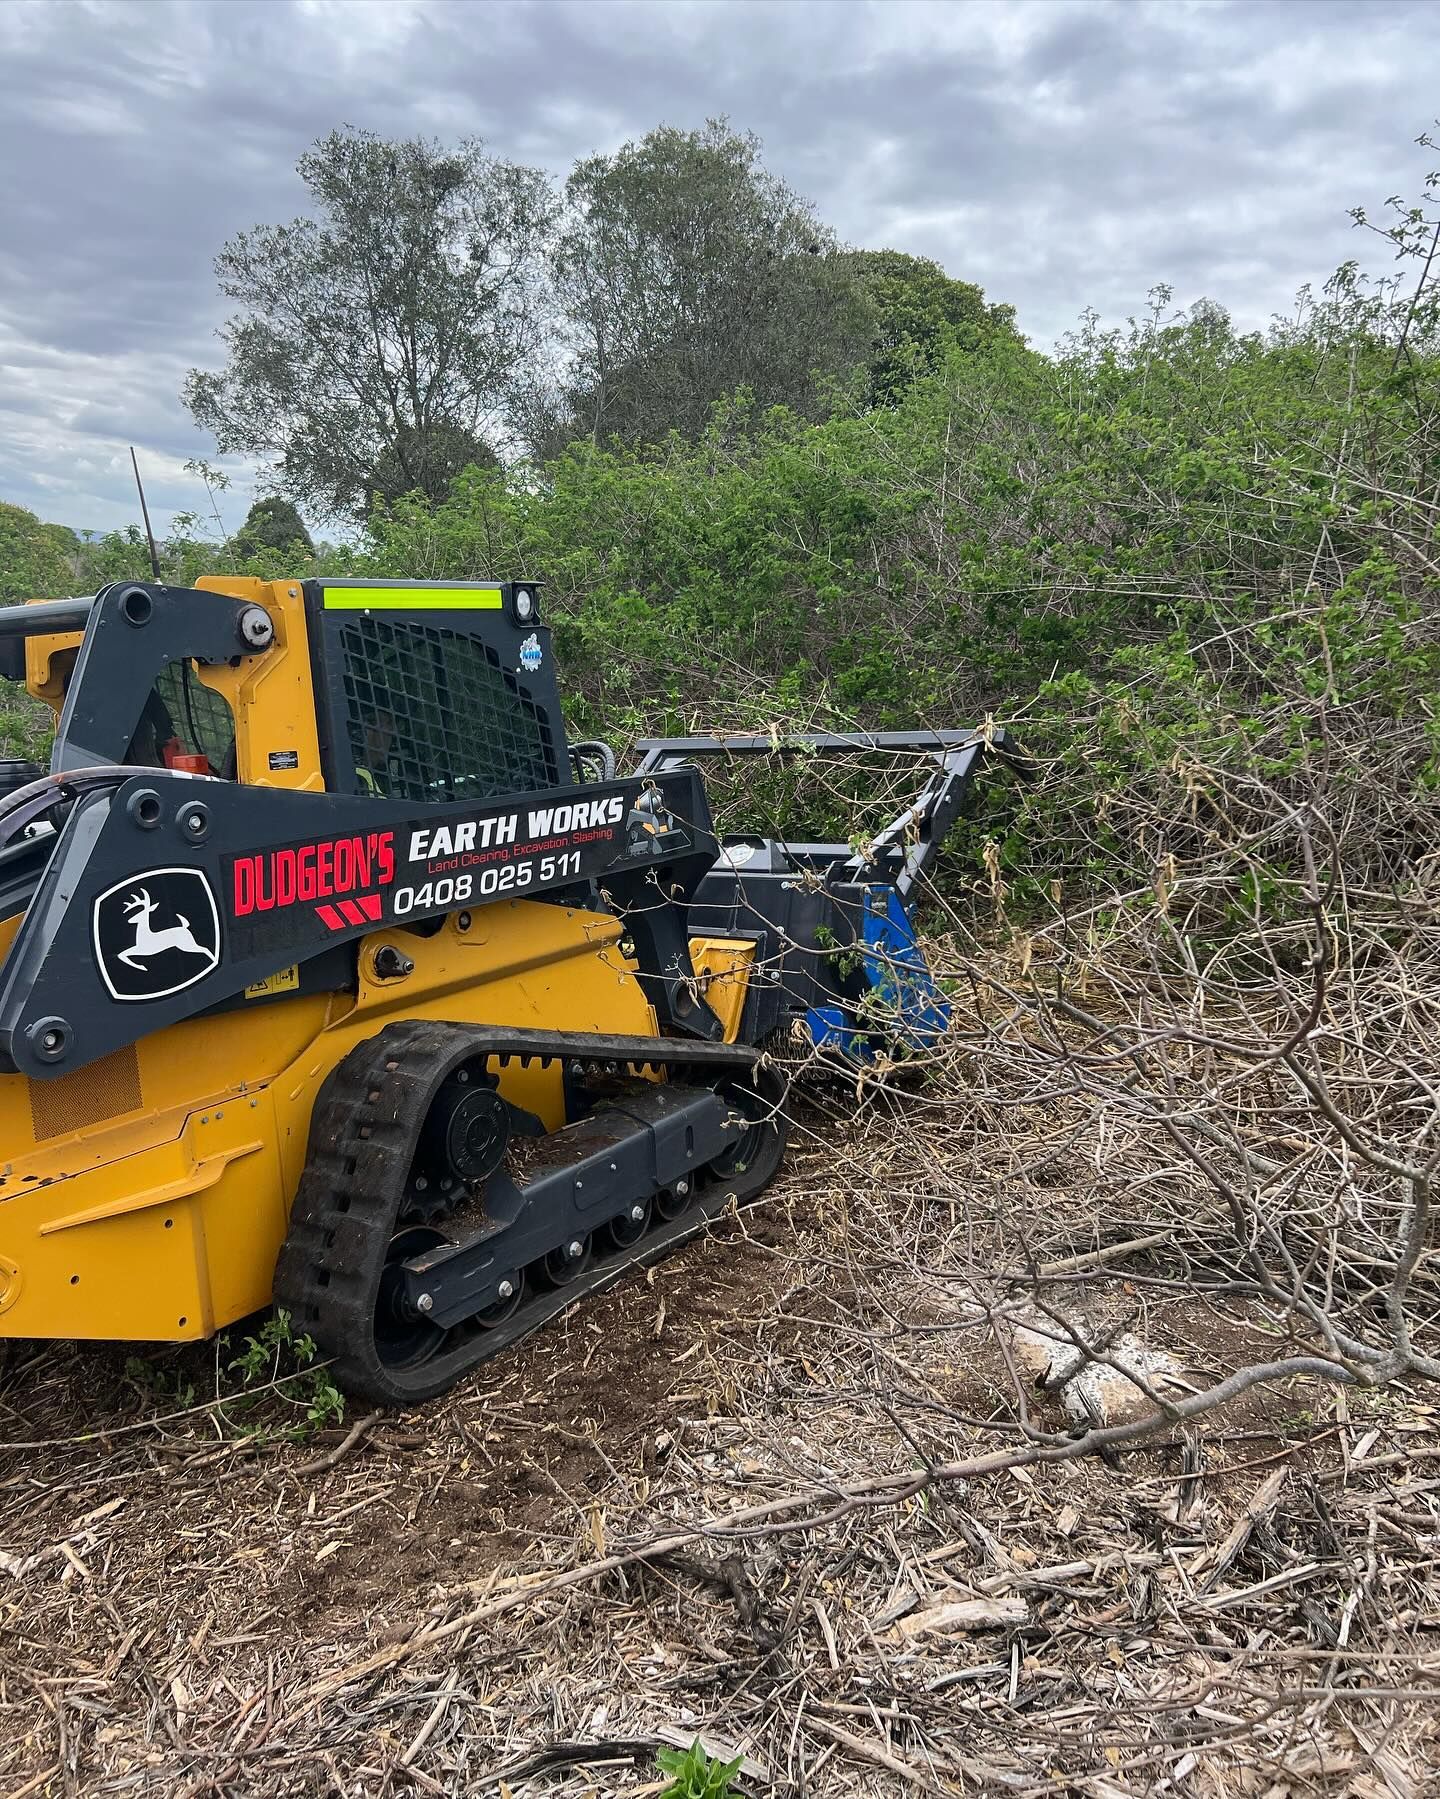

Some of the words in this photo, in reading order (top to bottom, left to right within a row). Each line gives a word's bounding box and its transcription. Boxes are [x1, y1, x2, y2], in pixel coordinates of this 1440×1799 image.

[408, 814, 518, 862] EARTH
[528, 796, 624, 839] WORKS
[428, 855, 458, 874] Land
[572, 827, 613, 844] Slashing
[234, 831, 394, 917] DUDGEON'S
[393, 874, 473, 915] 0408
[480, 861, 532, 895] 025
[539, 850, 581, 881] 511
